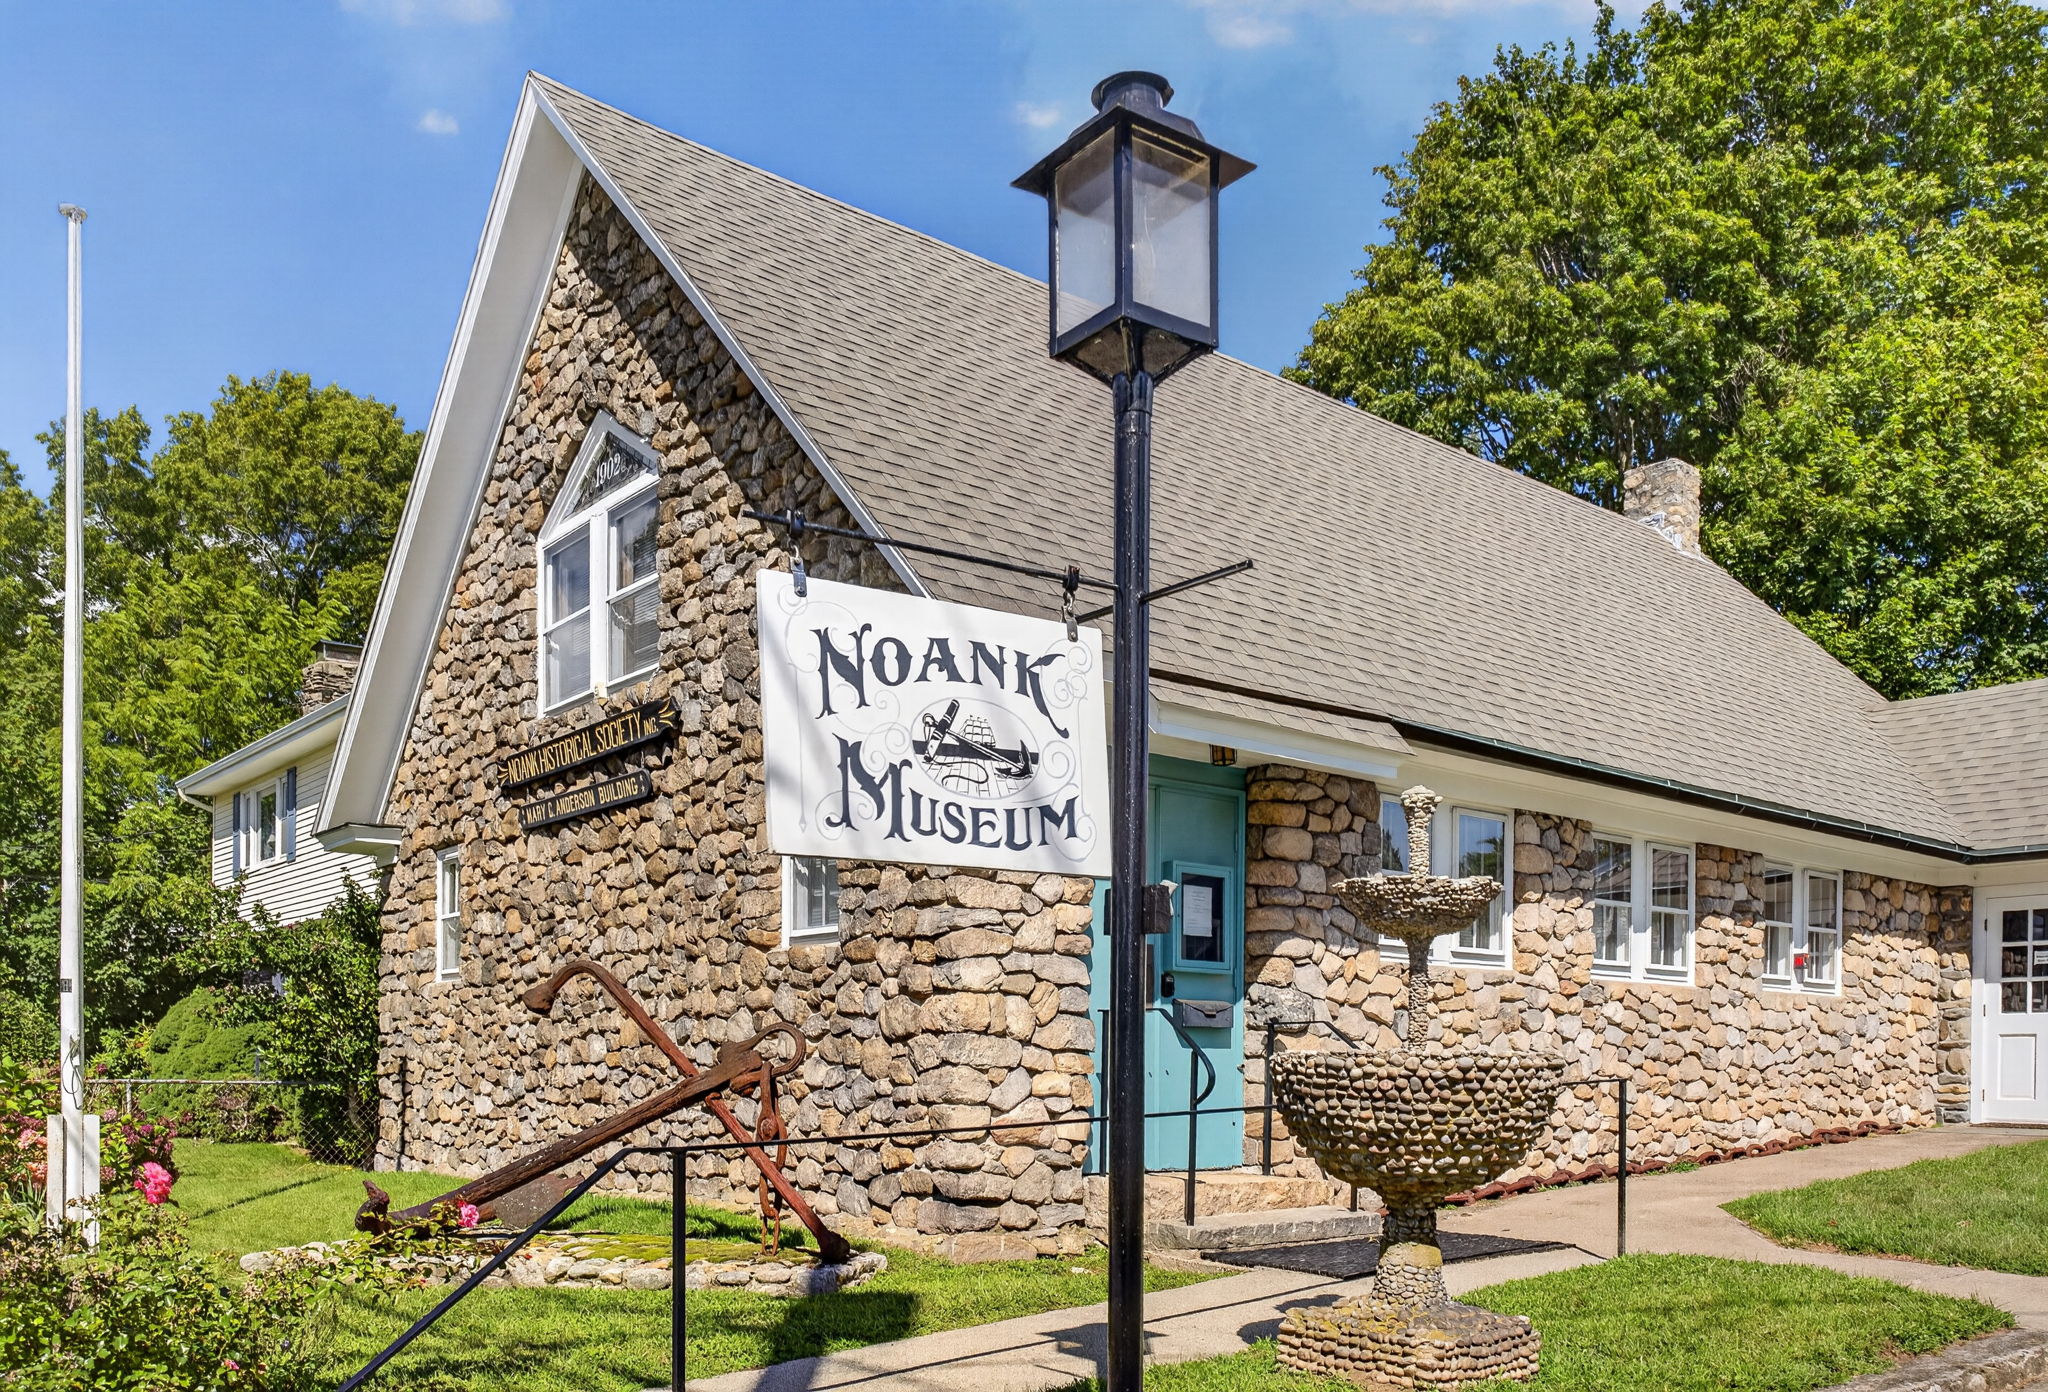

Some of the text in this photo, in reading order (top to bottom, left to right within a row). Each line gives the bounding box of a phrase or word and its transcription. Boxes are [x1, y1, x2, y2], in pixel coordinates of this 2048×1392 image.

[595, 453, 621, 488] 1902
[810, 623, 1070, 739] NOANK
[507, 711, 659, 785] NOANK HISTORICAL SOCIETY INC.
[526, 803, 546, 825] MARY
[555, 789, 596, 816] ANDERSON
[598, 777, 639, 805] BUILDING
[825, 732, 1080, 851] MUSEUM
